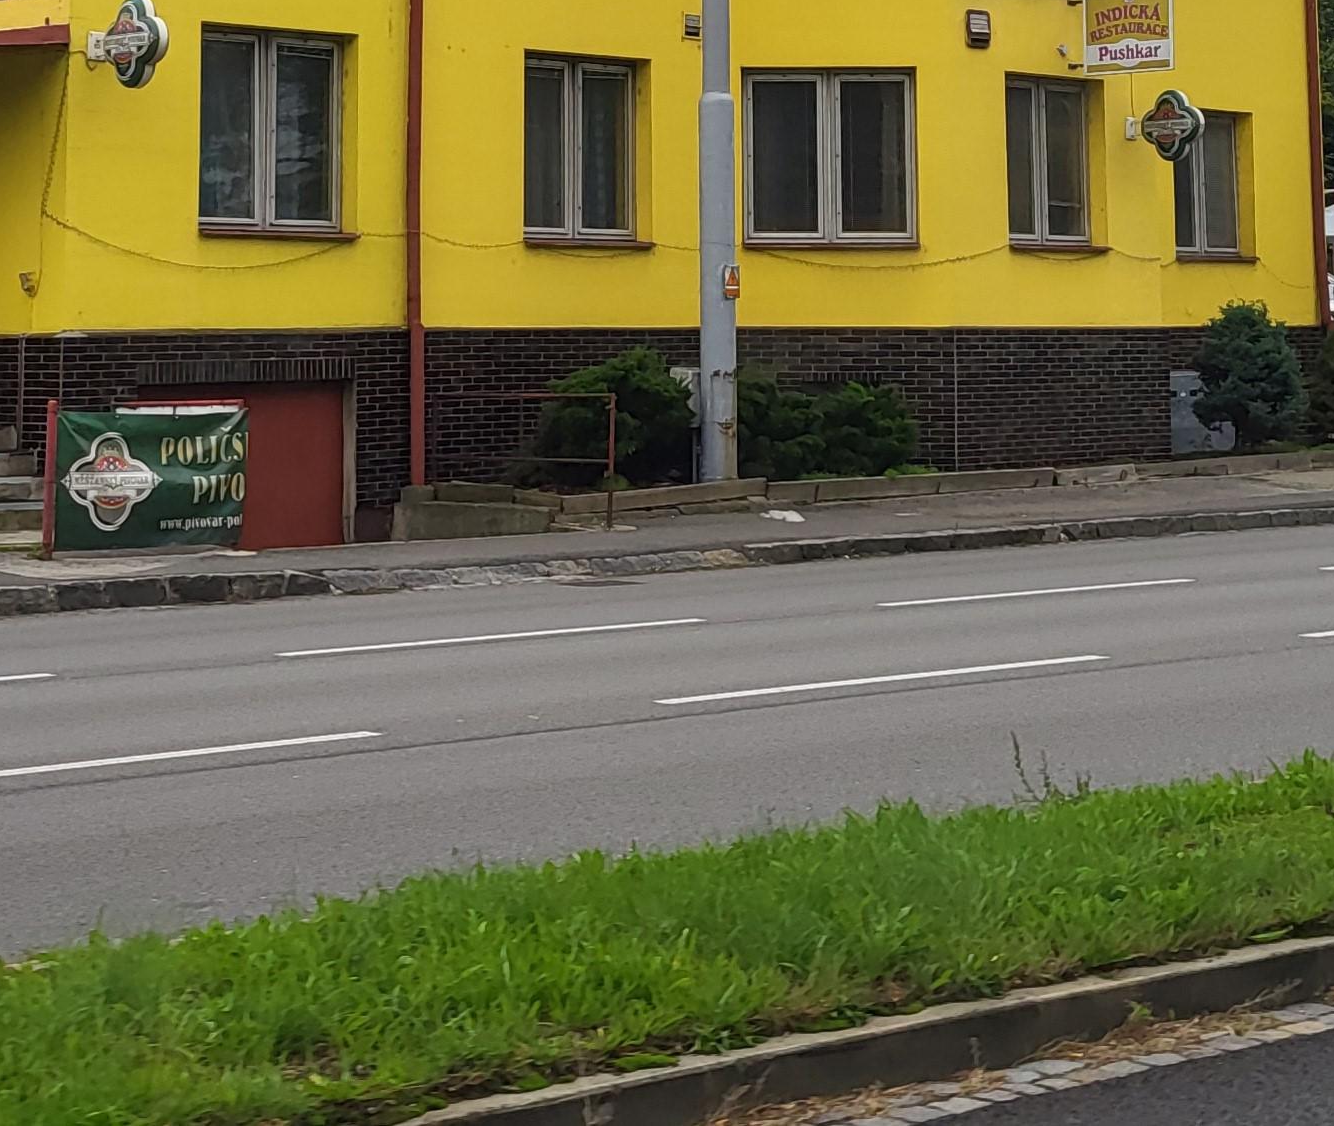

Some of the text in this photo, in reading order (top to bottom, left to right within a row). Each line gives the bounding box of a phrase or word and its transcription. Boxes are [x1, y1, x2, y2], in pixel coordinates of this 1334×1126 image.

[1095, 2, 1161, 27] INDICKÁ
[1090, 22, 1169, 43] RESTAURACE
[1098, 43, 1162, 62] Pushkar
[160, 425, 249, 465] POLIČS
[192, 472, 245, 504] PIVO
[160, 514, 242, 531] www.pivovar-pol
